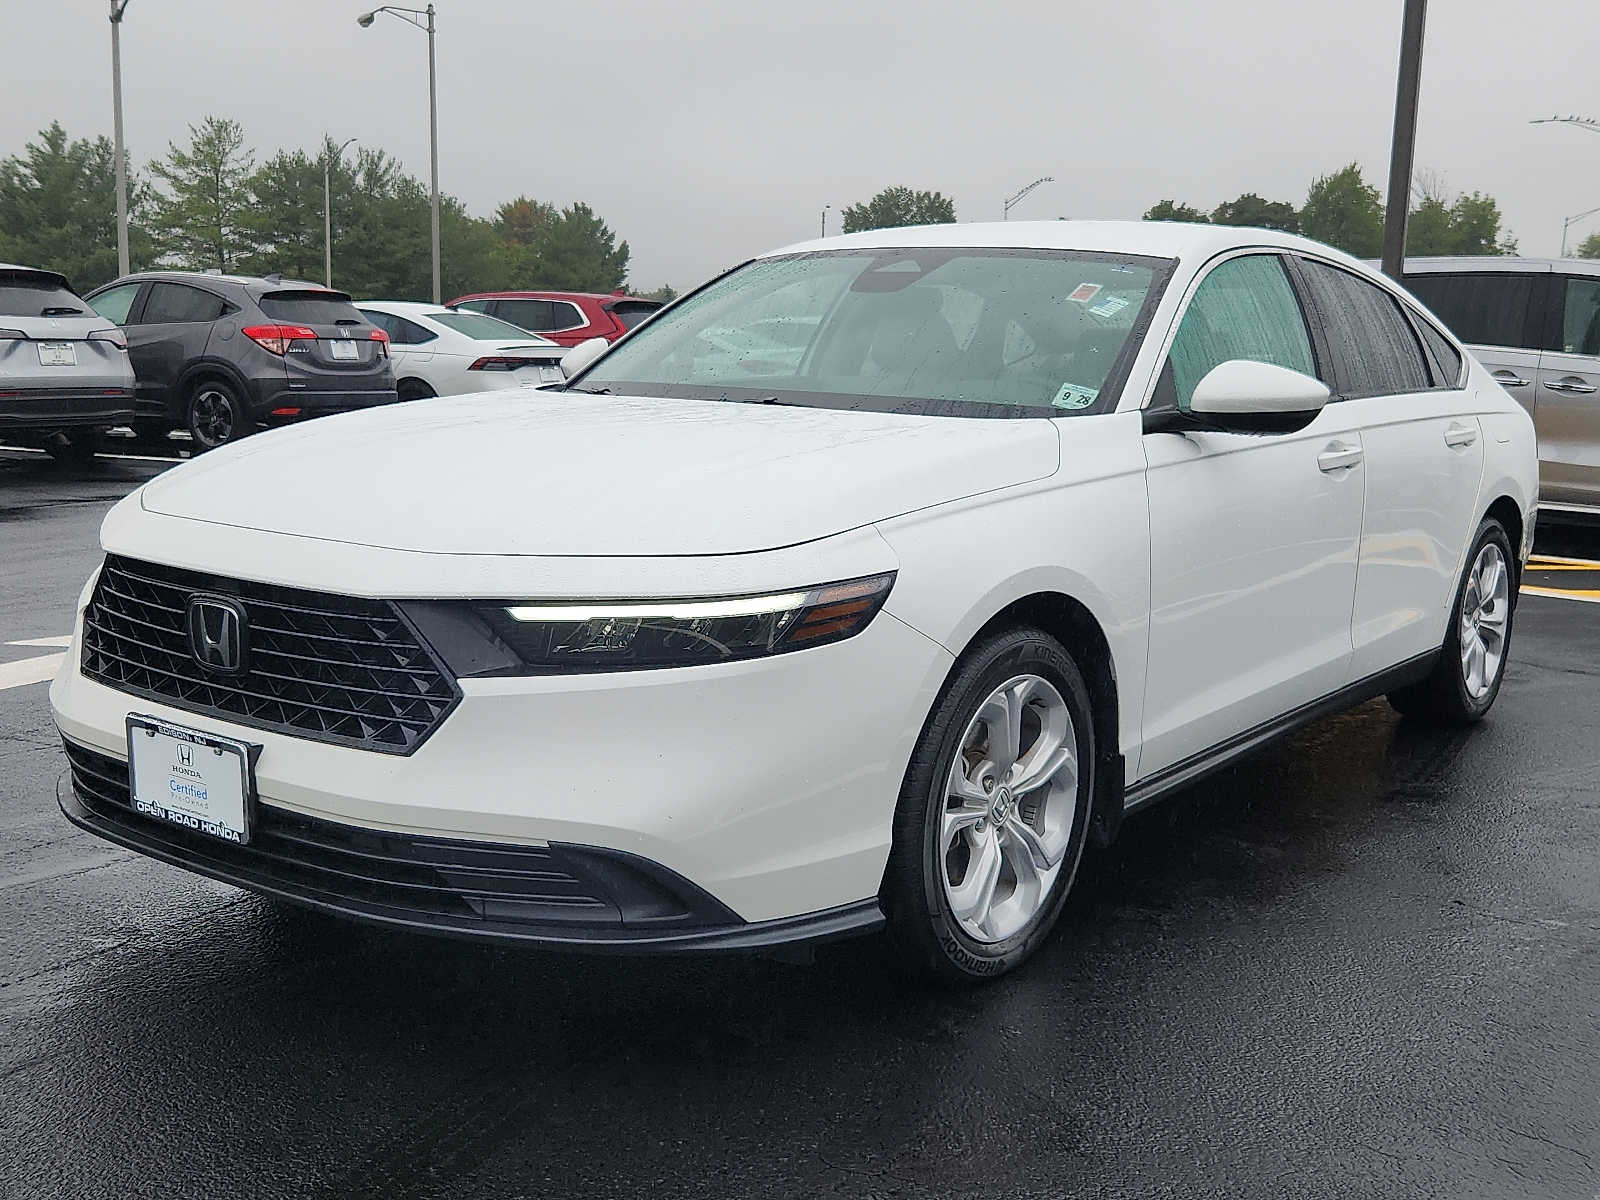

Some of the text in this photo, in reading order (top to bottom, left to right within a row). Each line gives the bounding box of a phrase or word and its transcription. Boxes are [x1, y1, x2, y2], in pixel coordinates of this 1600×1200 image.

[1063, 391, 1092, 406] 9 28
[194, 736, 207, 745] NJ
[172, 765, 202, 779] HONDA
[169, 779, 208, 800] Certified
[136, 801, 166, 819] OPEN
[168, 811, 199, 829] ROAD
[201, 820, 241, 843] HONDA
